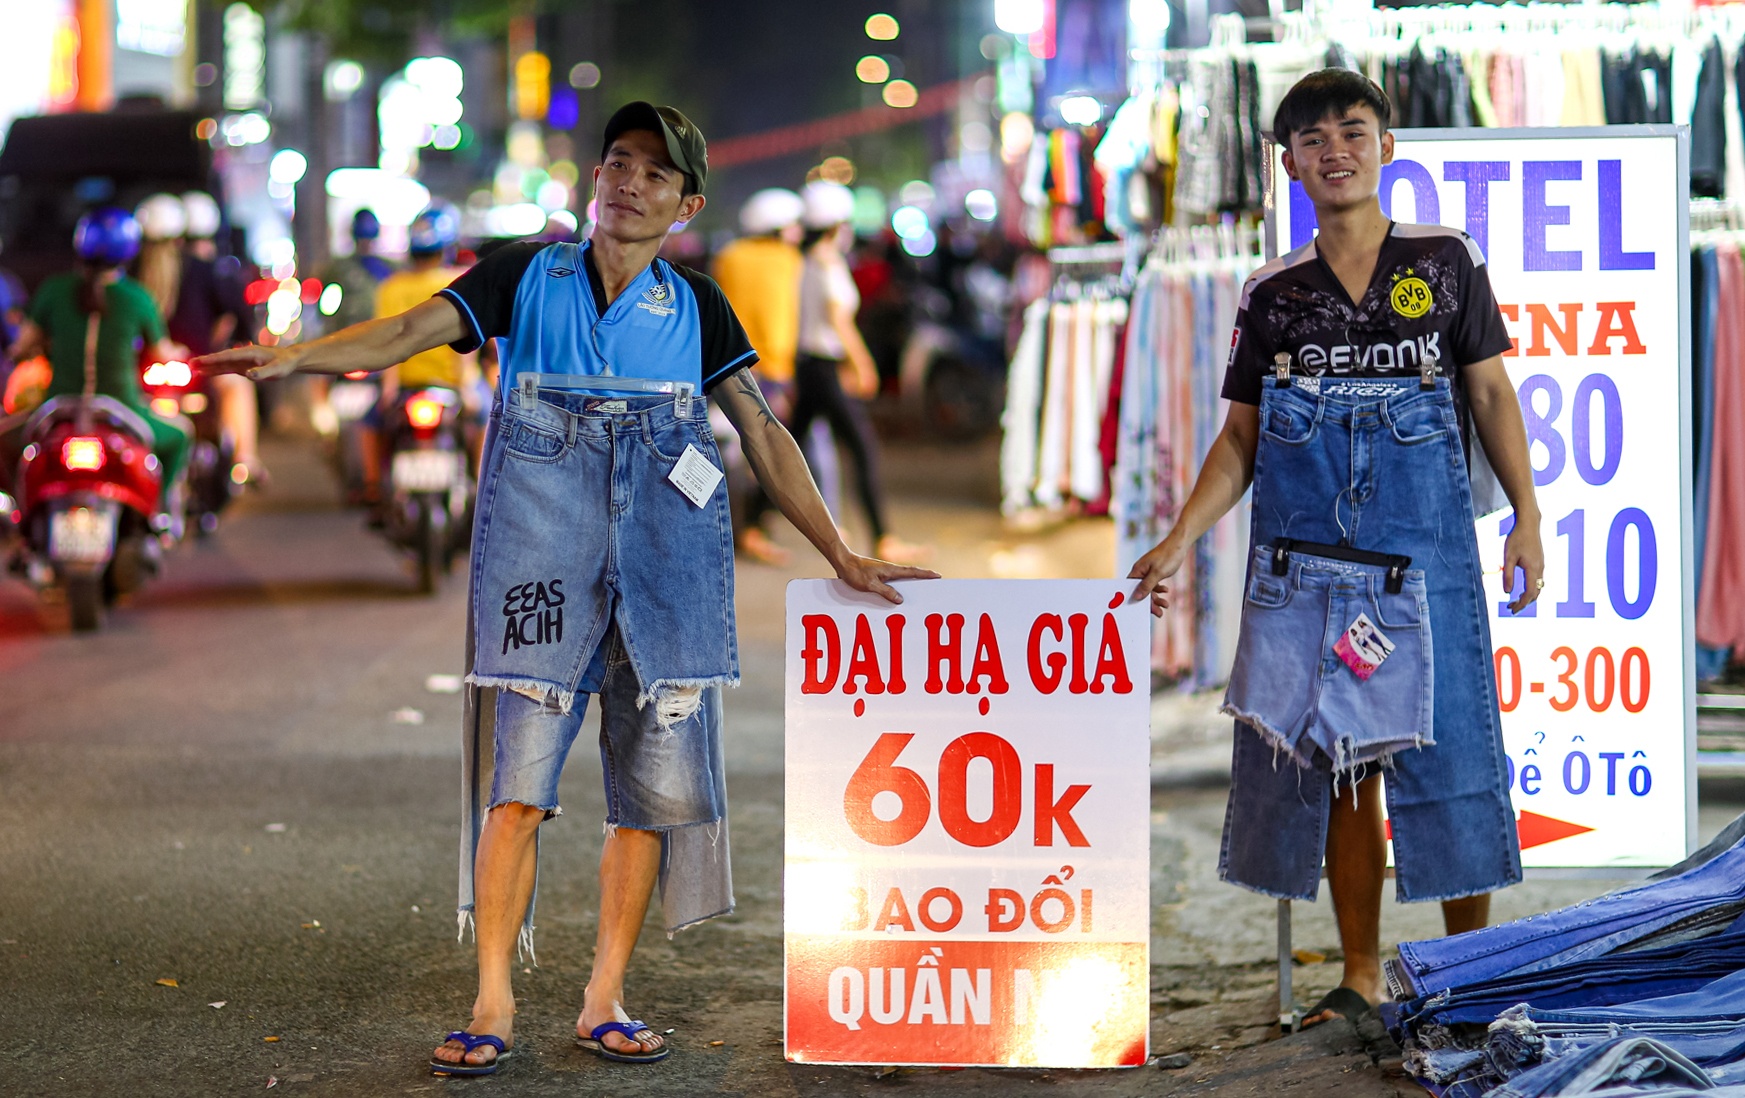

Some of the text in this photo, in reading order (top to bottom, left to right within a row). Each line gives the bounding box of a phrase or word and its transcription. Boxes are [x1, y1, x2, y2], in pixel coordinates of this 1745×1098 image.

[1397, 283, 1426, 308] BVB
[1410, 301, 1422, 311] 09
[800, 591, 1133, 718] ĐẠI HẠ GIÁ
[984, 865, 1093, 934] ĐỔI
[828, 947, 991, 1031] QUẦN
